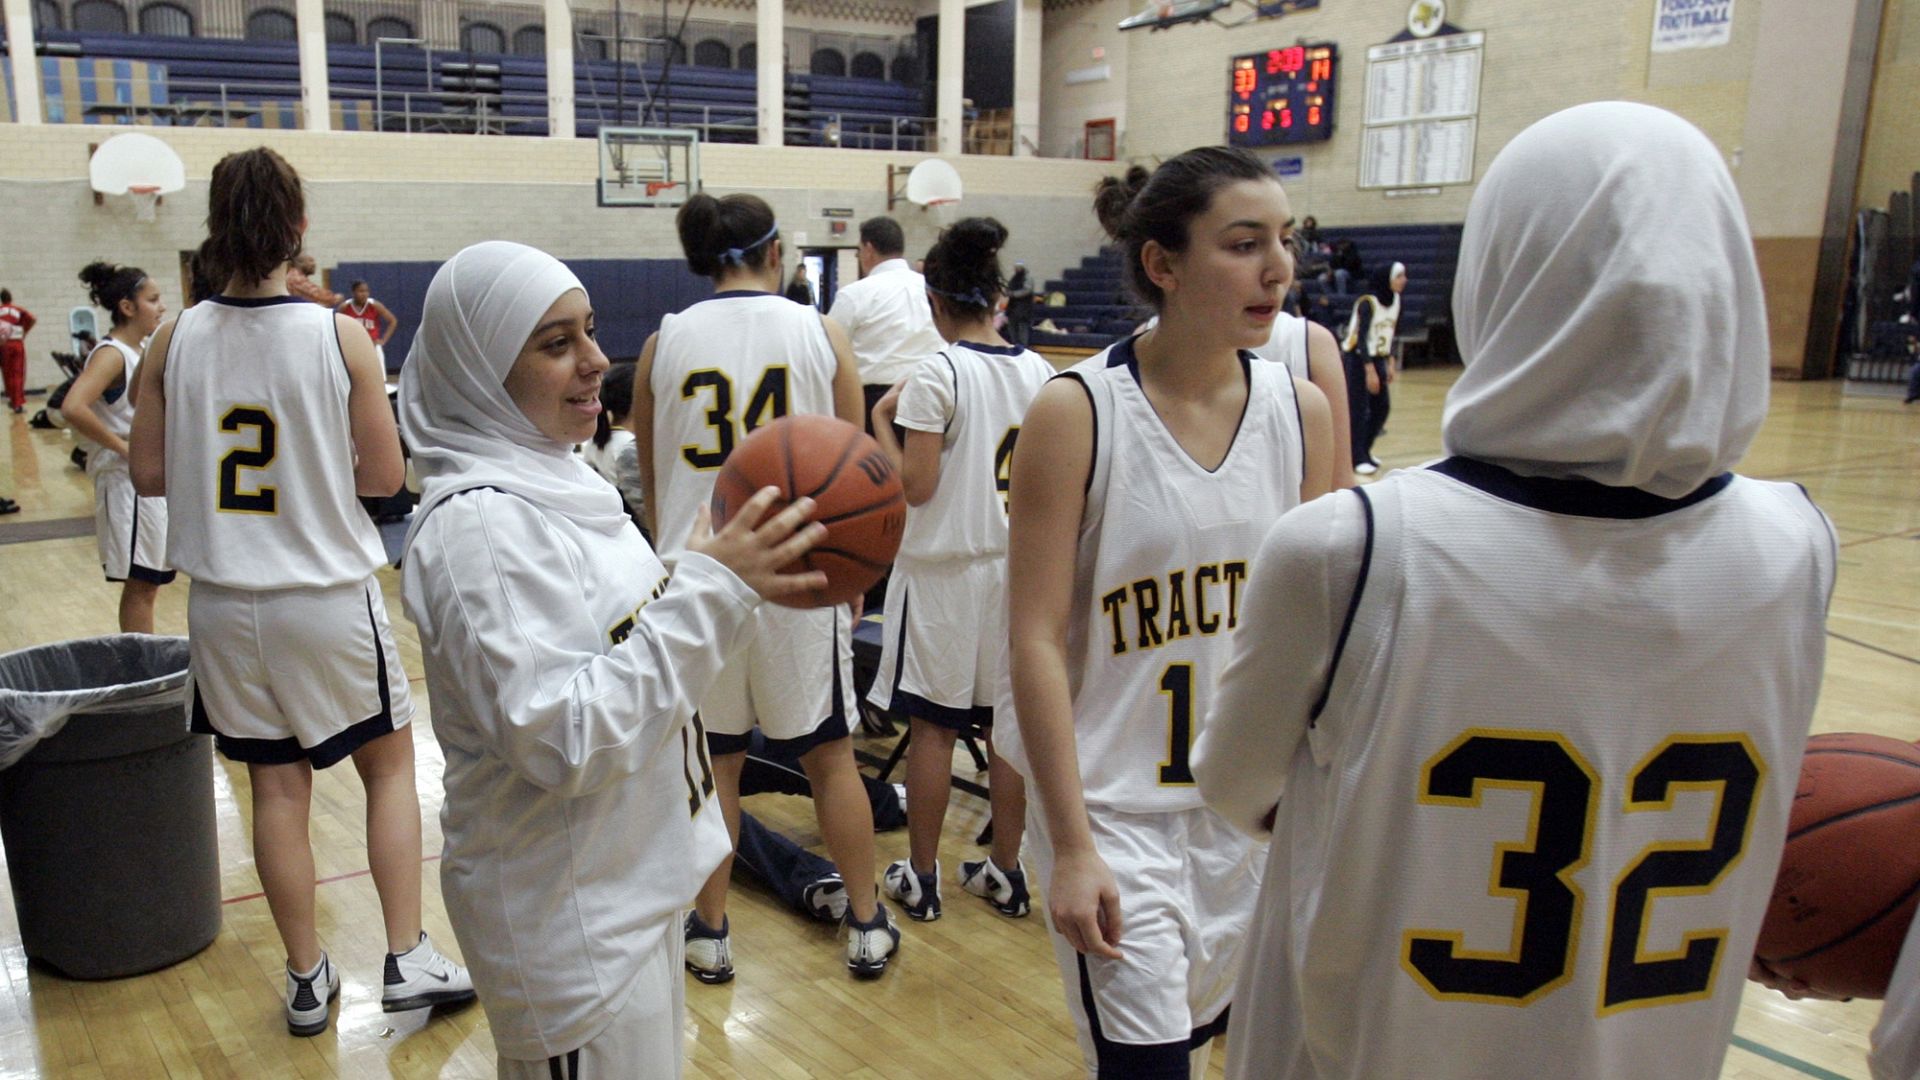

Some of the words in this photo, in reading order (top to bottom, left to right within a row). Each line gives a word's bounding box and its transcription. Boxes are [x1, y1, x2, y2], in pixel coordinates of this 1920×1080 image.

[1659, 7, 1730, 30] FOOTBALL
[216, 403, 279, 517] 2
[679, 363, 791, 473] 34
[1100, 559, 1248, 656] TRACT
[1157, 661, 1197, 787] 1
[1401, 727, 1769, 1018] 32
